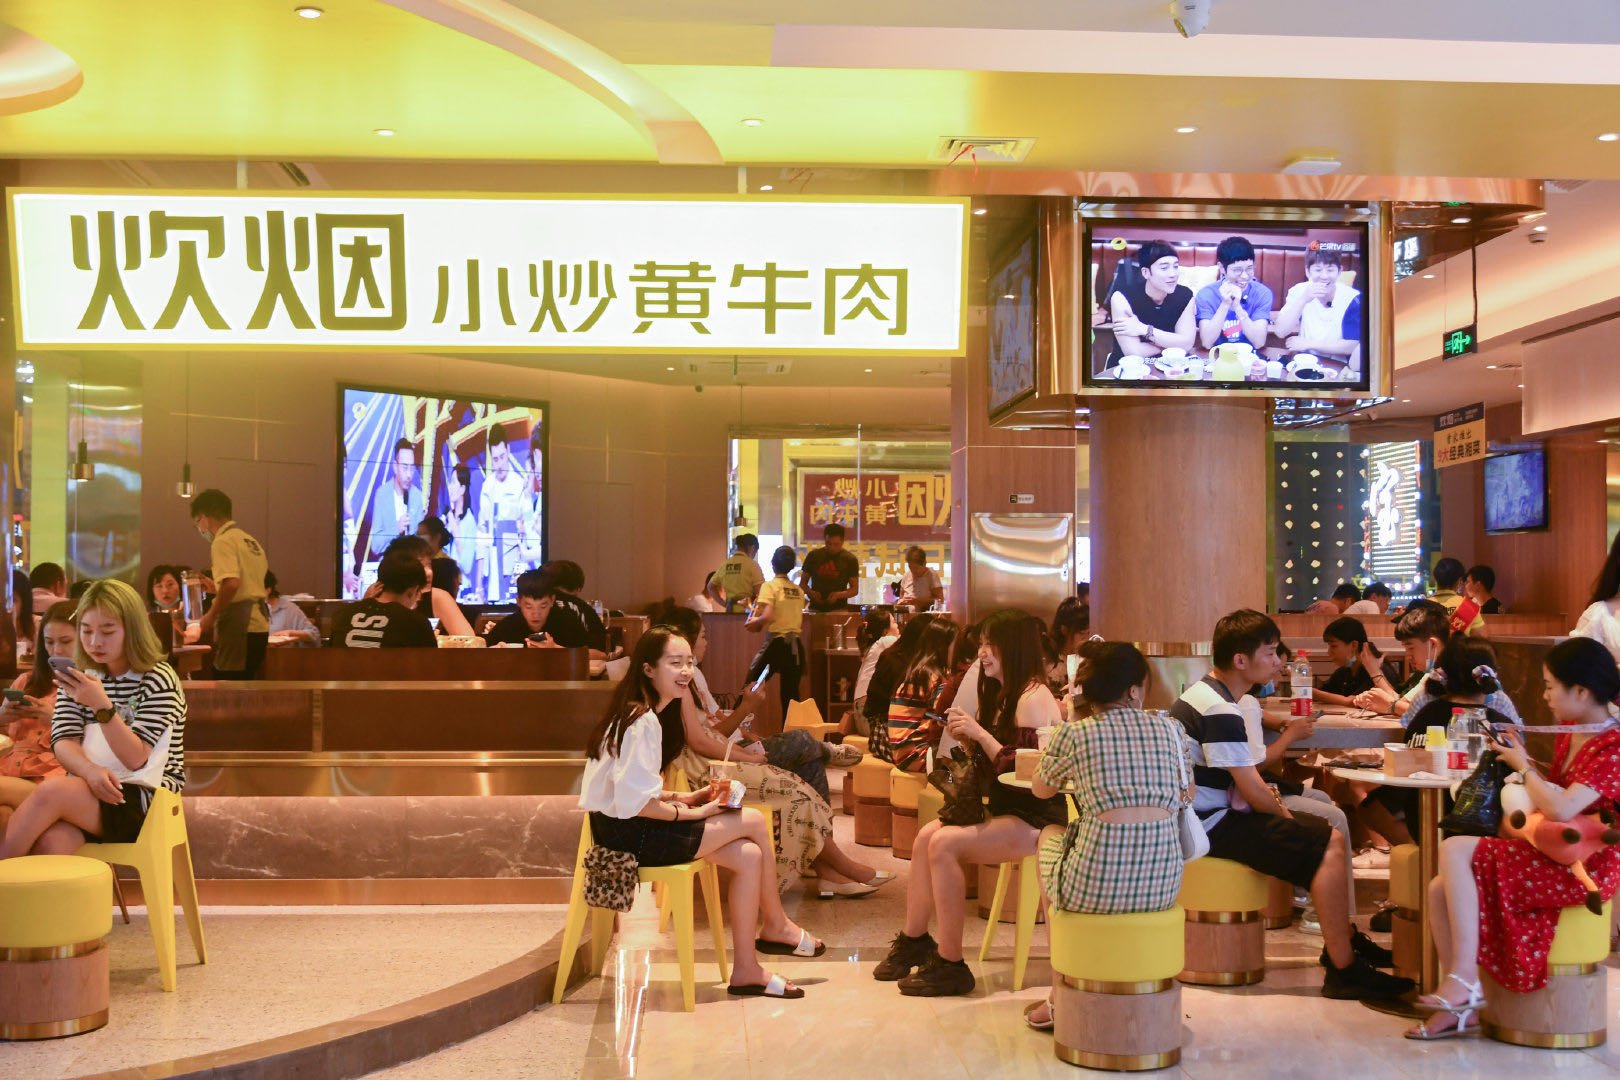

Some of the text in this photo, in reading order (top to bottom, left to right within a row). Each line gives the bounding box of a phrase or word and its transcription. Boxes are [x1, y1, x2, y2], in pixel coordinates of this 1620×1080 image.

[70, 210, 909, 336] 炊烟 小炒黄牛肉
